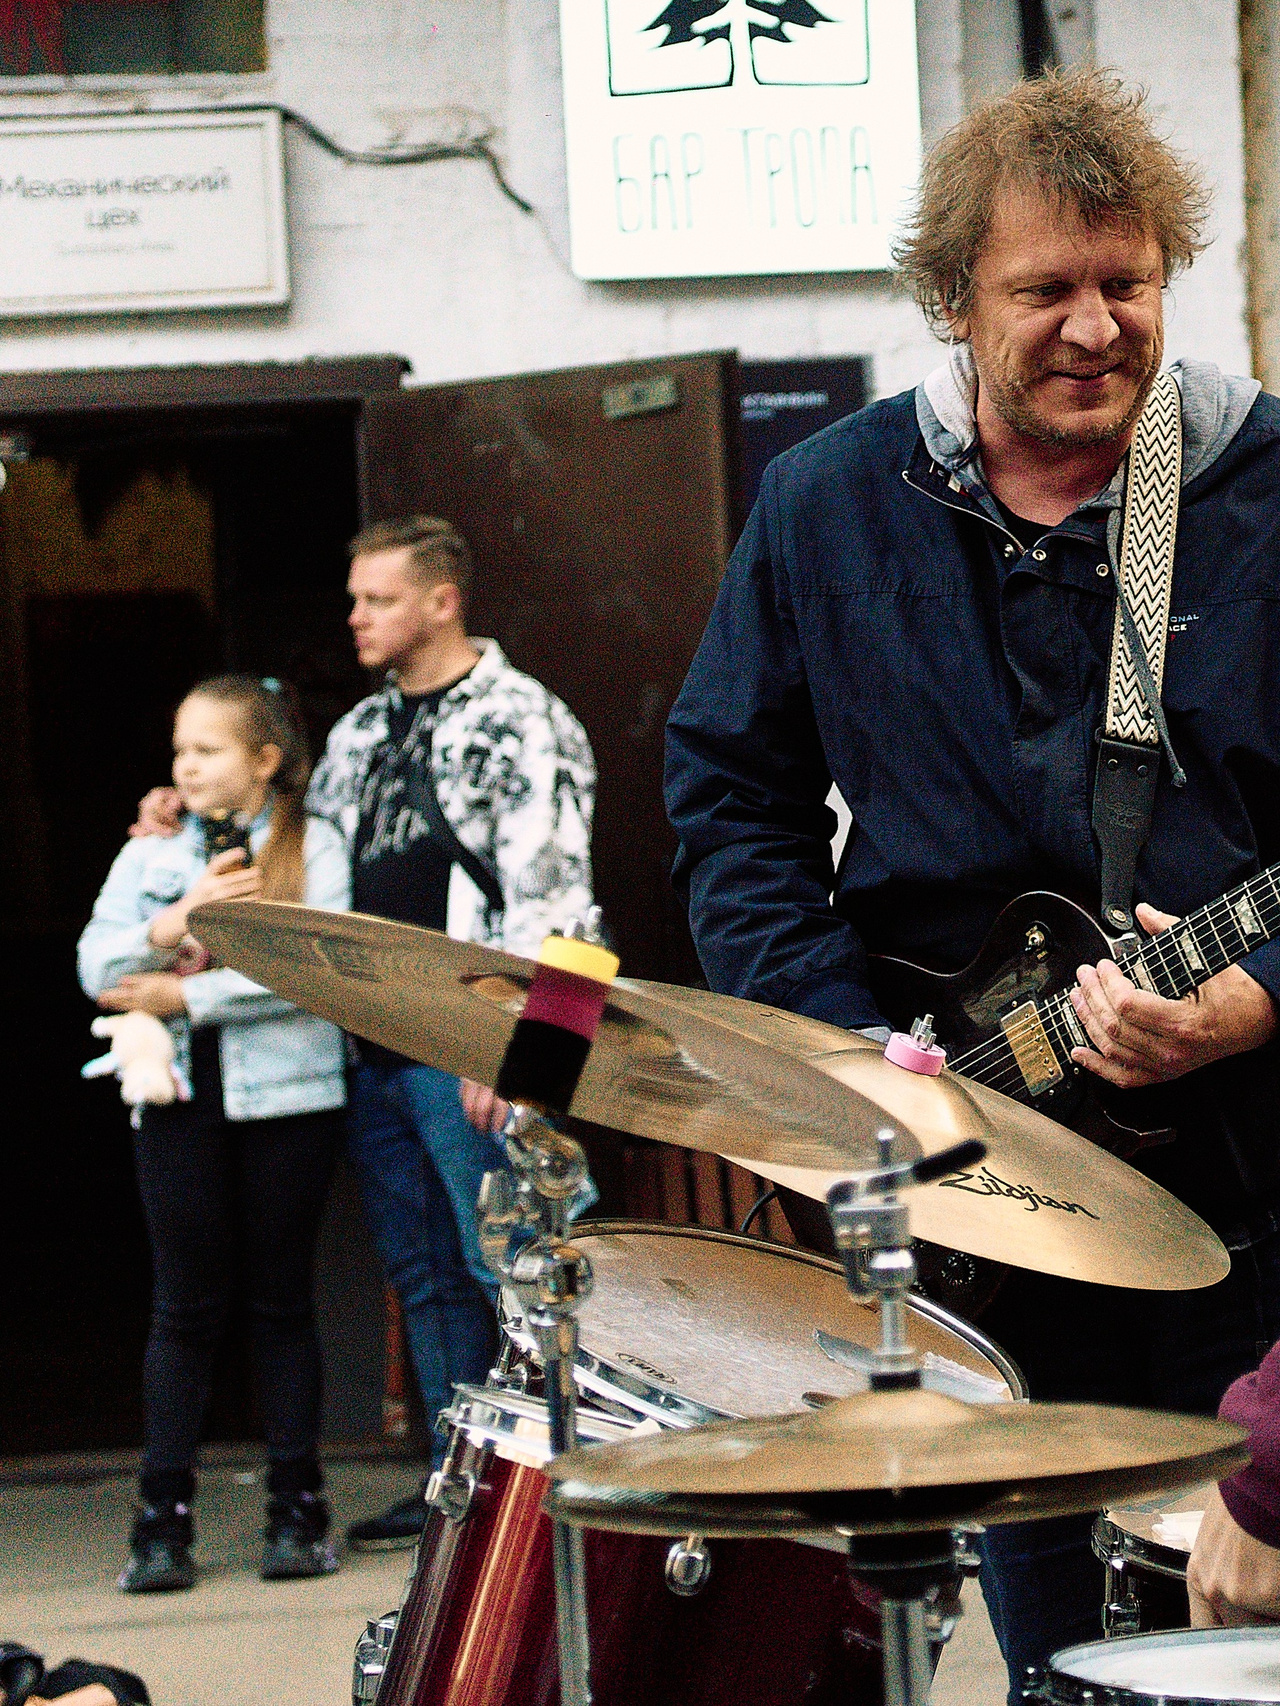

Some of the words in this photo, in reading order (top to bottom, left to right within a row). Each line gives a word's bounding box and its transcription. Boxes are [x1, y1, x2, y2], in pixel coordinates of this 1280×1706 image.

[611, 131, 705, 233] БАР
[730, 126, 878, 228] ТРОПА
[938, 1166, 1101, 1221] Zildjian
